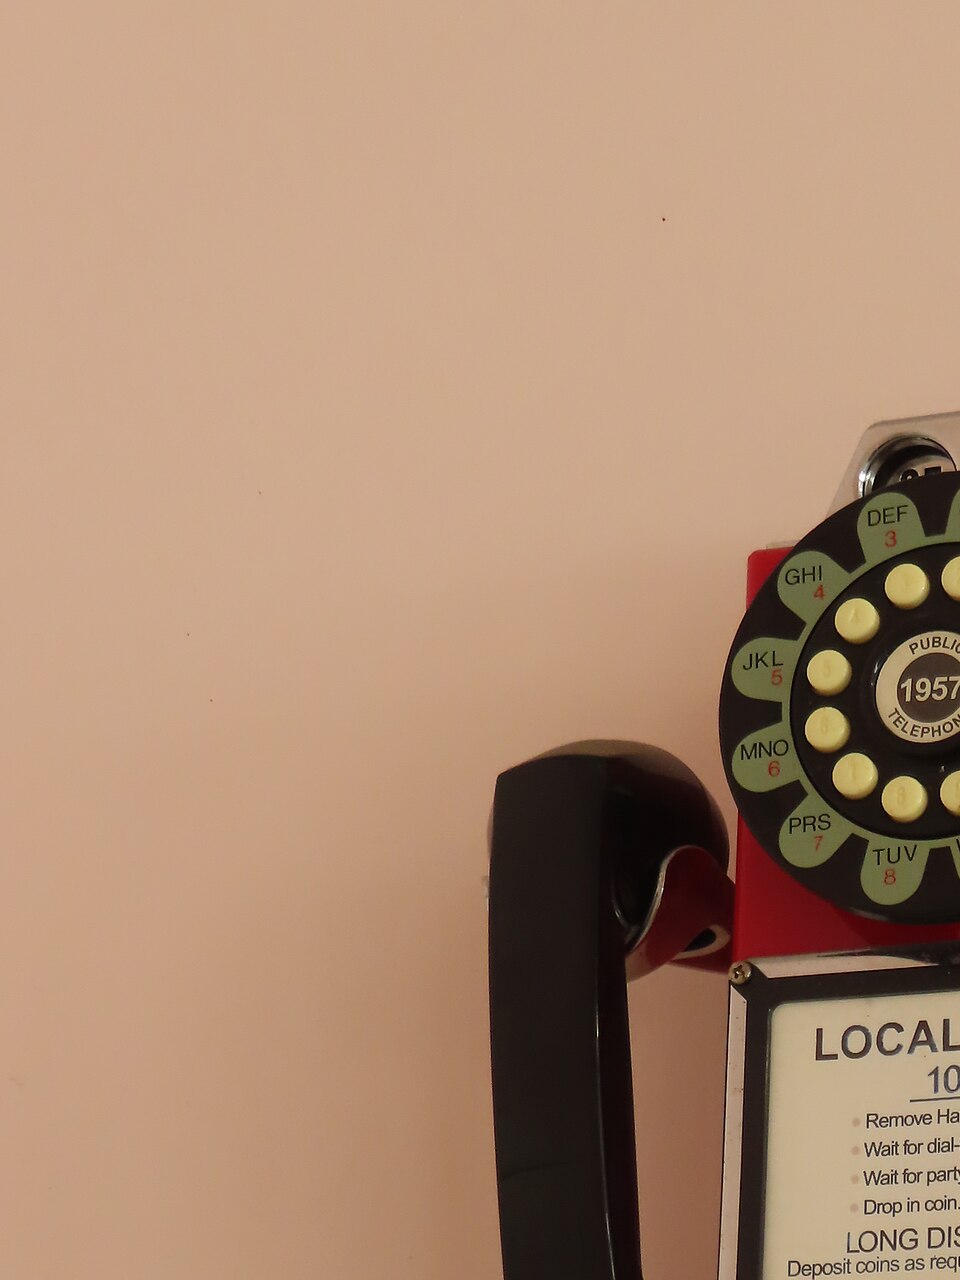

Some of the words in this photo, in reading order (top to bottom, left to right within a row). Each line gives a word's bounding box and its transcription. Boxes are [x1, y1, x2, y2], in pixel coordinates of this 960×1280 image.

[867, 504, 909, 527] DEF
[883, 530, 898, 548] 3
[784, 564, 823, 586] GHI
[813, 584, 826, 601] 4
[742, 650, 784, 671] JKL
[771, 669, 784, 686] 5
[740, 739, 789, 761] MNO
[767, 760, 781, 778] 6
[788, 813, 832, 835] PRS
[813, 835, 825, 852] 7
[872, 844, 918, 867] TUV
[883, 868, 897, 886] 8
[865, 1110, 933, 1130] Remove
[863, 1140, 900, 1158] Wait
[903, 1138, 923, 1156] for
[863, 1168, 899, 1187] Wait
[902, 1168, 923, 1186] for
[863, 1198, 903, 1218] Drop
[906, 1197, 920, 1213] in
[924, 1195, 960, 1212] coin.
[846, 1227, 919, 1254] LONG
[787, 1257, 852, 1280] Deposit
[855, 1254, 900, 1274] coins
[904, 1257, 925, 1272] as
